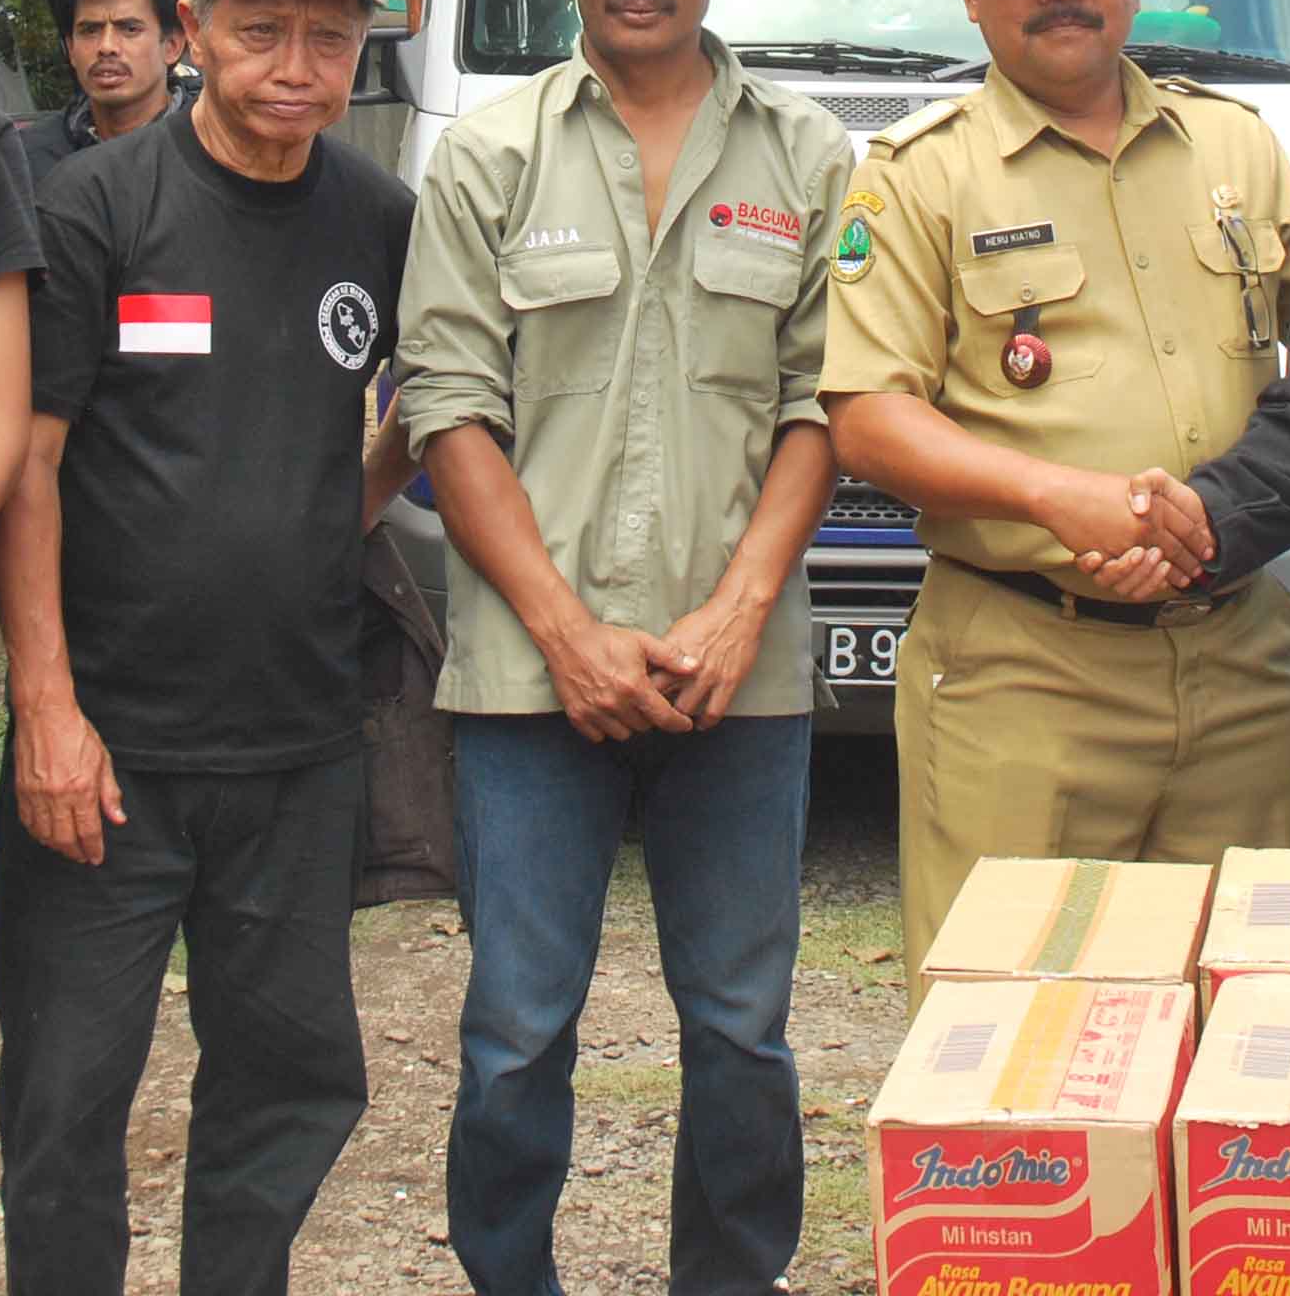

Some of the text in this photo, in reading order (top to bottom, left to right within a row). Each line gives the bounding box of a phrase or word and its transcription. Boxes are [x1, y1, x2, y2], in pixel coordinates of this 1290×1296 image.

[738, 202, 801, 233] BAGUNA
[829, 627, 908, 677] B 9
[942, 1225, 1033, 1246] Mi Instan
[1247, 1217, 1271, 1237] Mi
[939, 1263, 981, 1280] Rasa
[1243, 1255, 1286, 1273] Rasa
